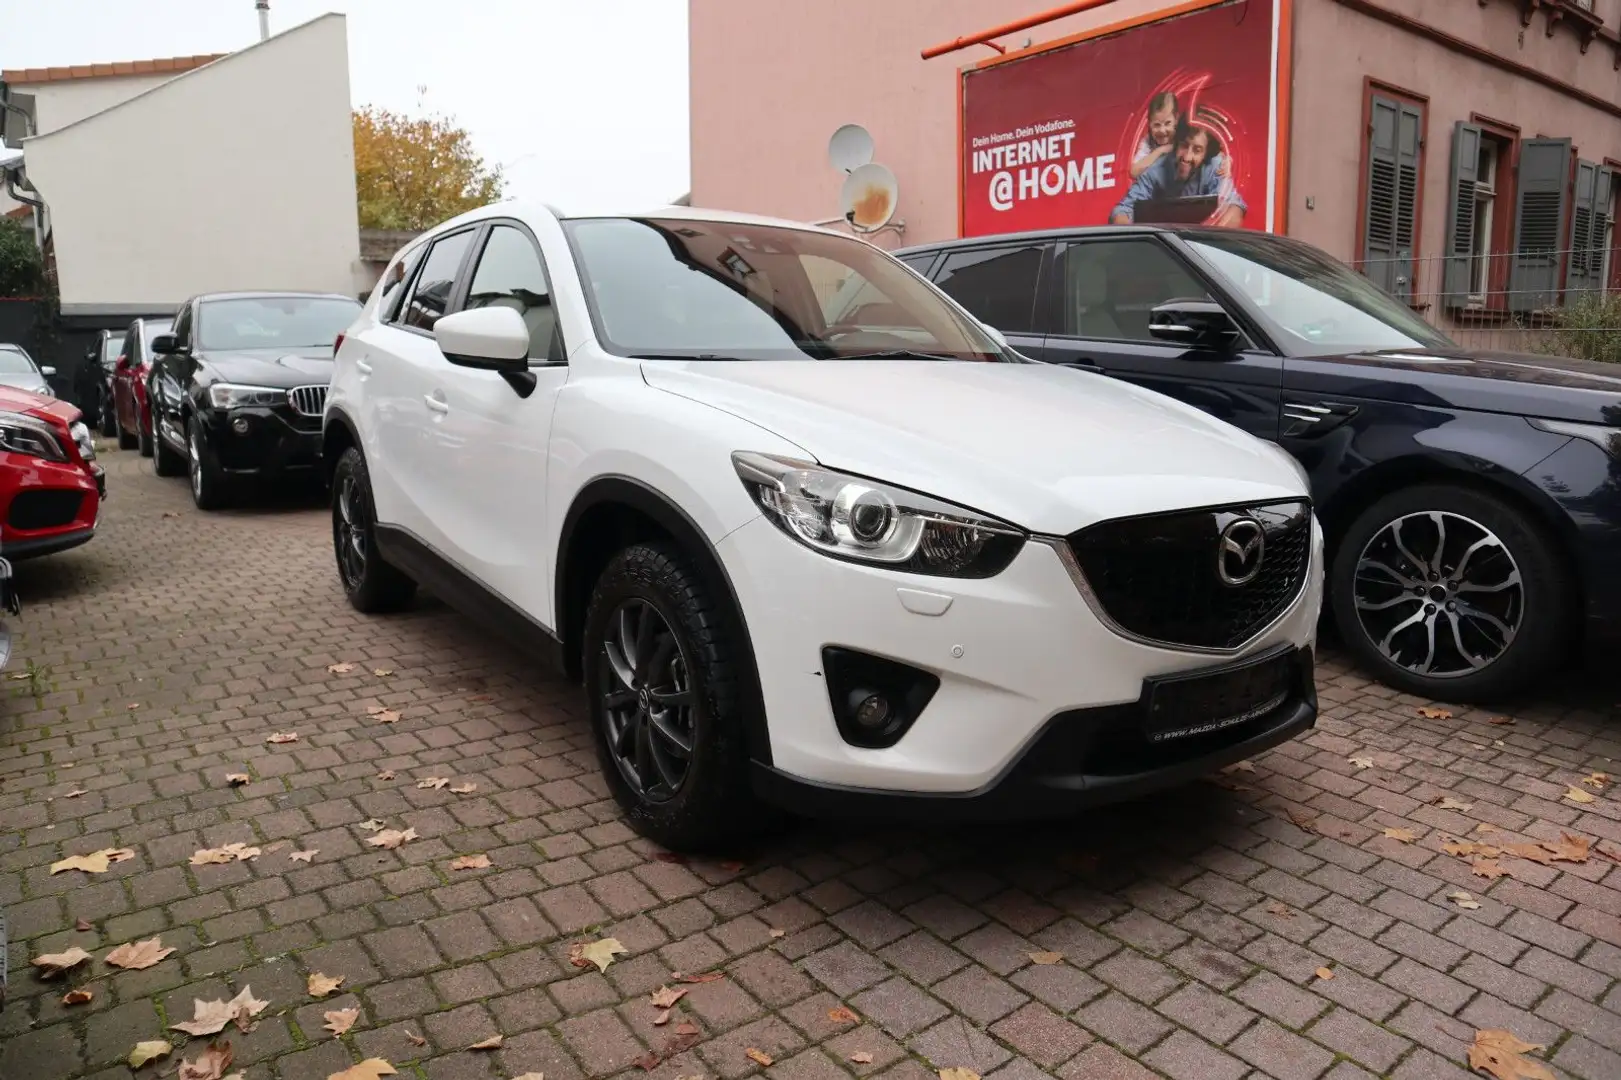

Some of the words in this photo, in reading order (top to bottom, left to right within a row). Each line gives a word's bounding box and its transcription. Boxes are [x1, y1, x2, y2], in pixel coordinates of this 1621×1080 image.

[972, 134, 989, 148] Dein
[990, 132, 1015, 144] Home.
[1015, 126, 1034, 139] Dein
[1034, 118, 1076, 134] Vodafone.
[972, 132, 1075, 174] INTERNET
